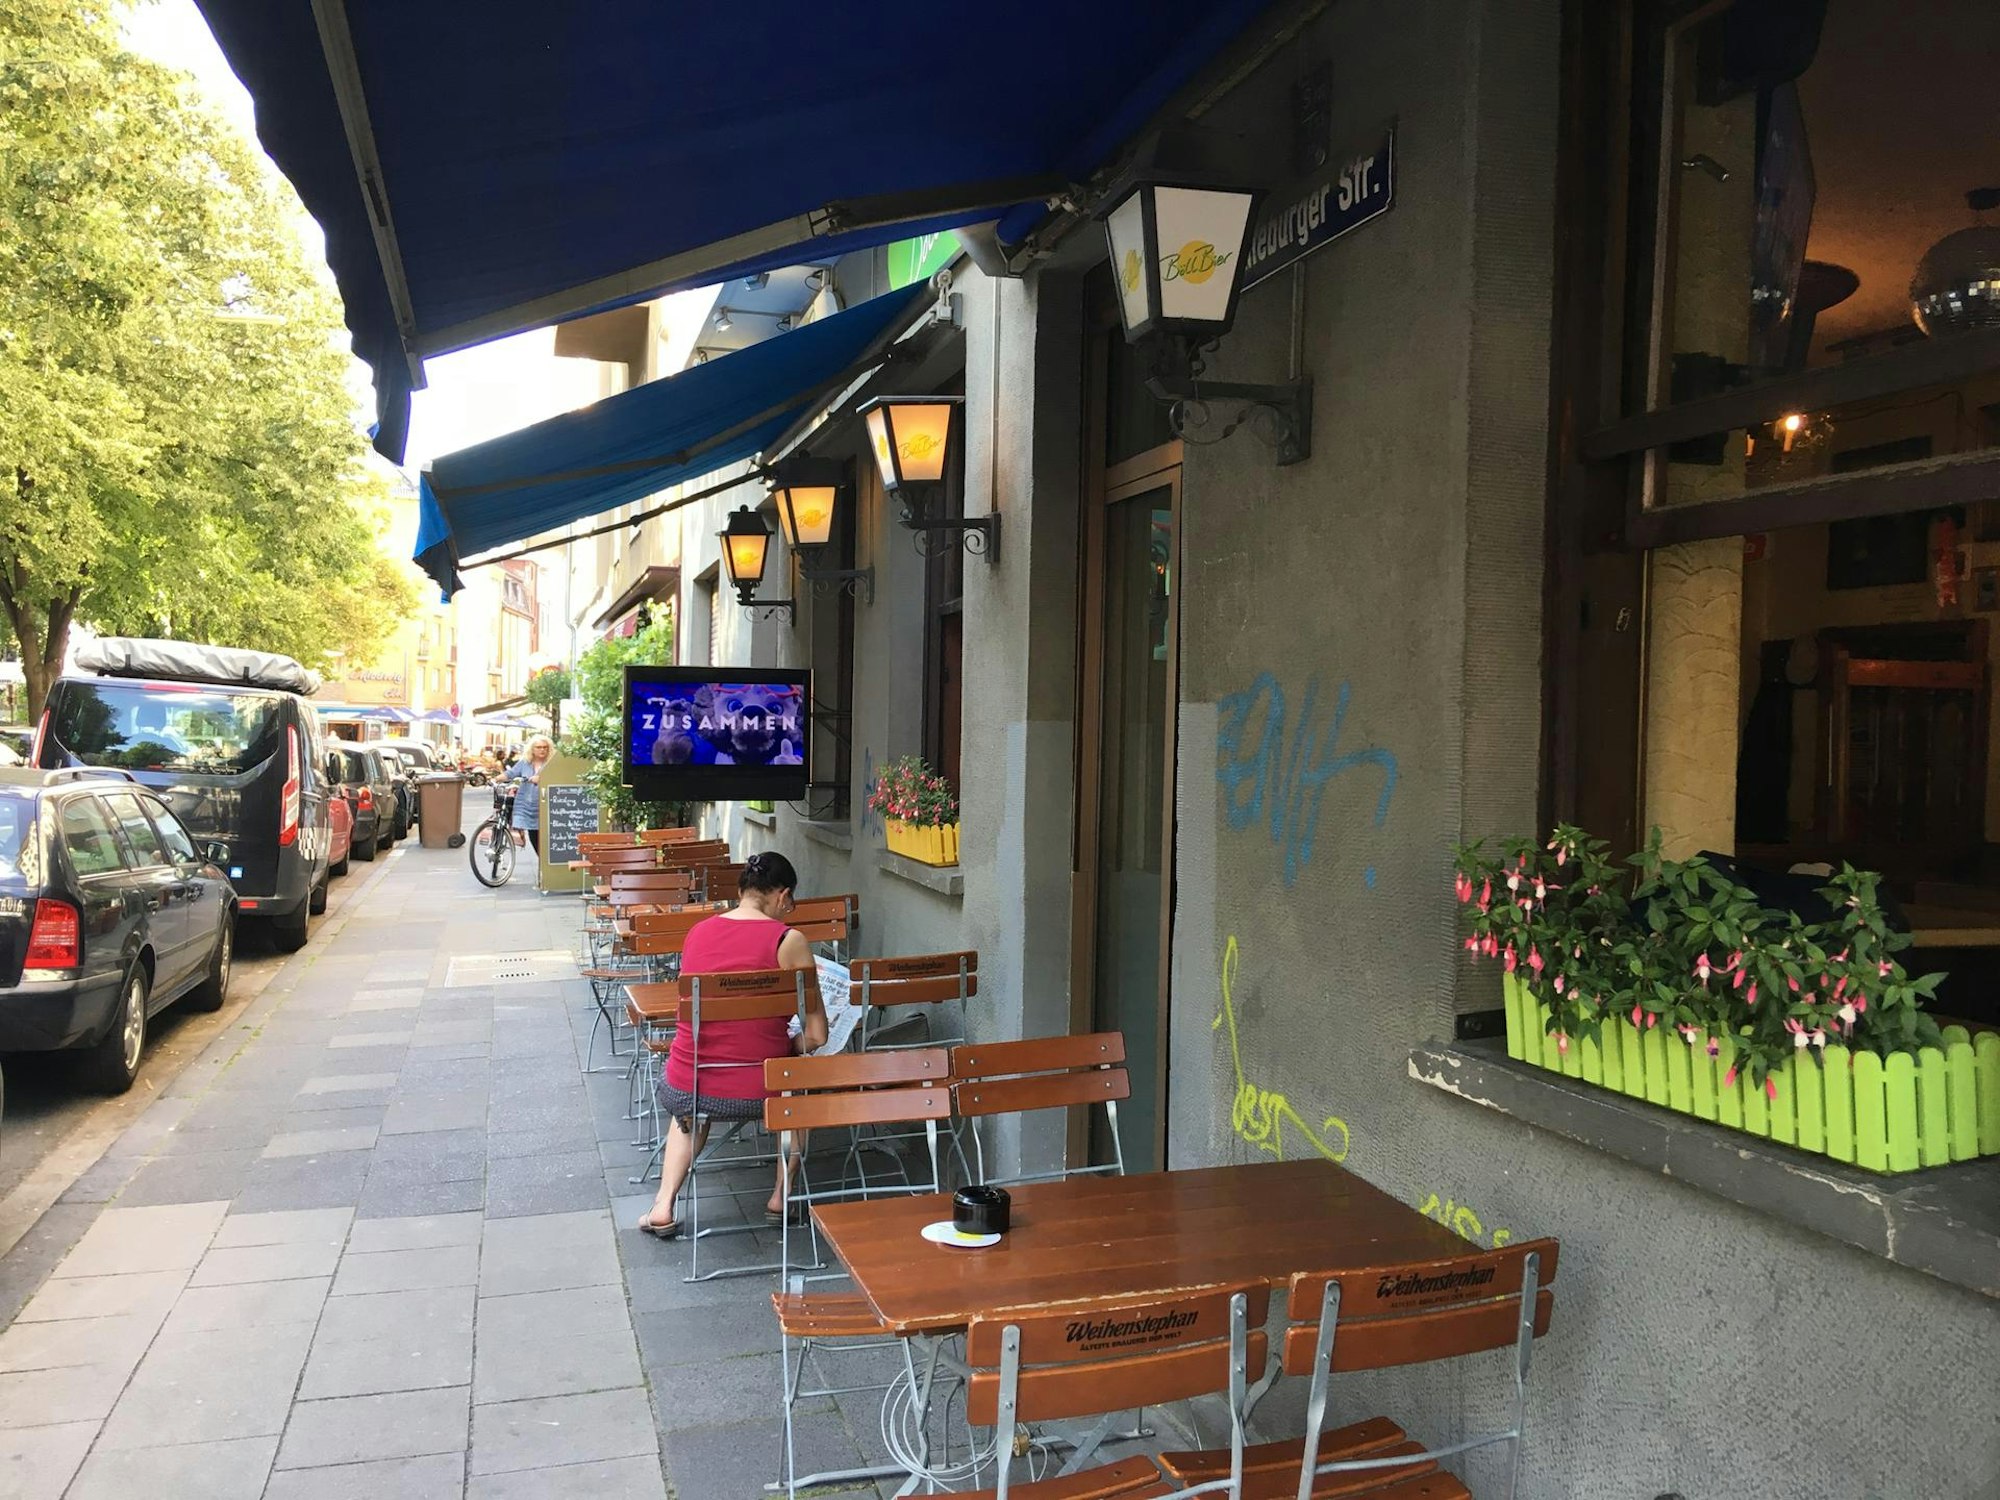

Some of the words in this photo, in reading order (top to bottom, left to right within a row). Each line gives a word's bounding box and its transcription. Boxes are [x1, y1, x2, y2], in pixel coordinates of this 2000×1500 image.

[1338, 155, 1380, 212] Str.
[642, 713, 797, 731] ZUSAMMEN
[0, 898, 23, 912] AVIA
[1376, 1265, 1496, 1299] Weihenstephan
[1065, 1309, 1199, 1343] Weihenstephan
